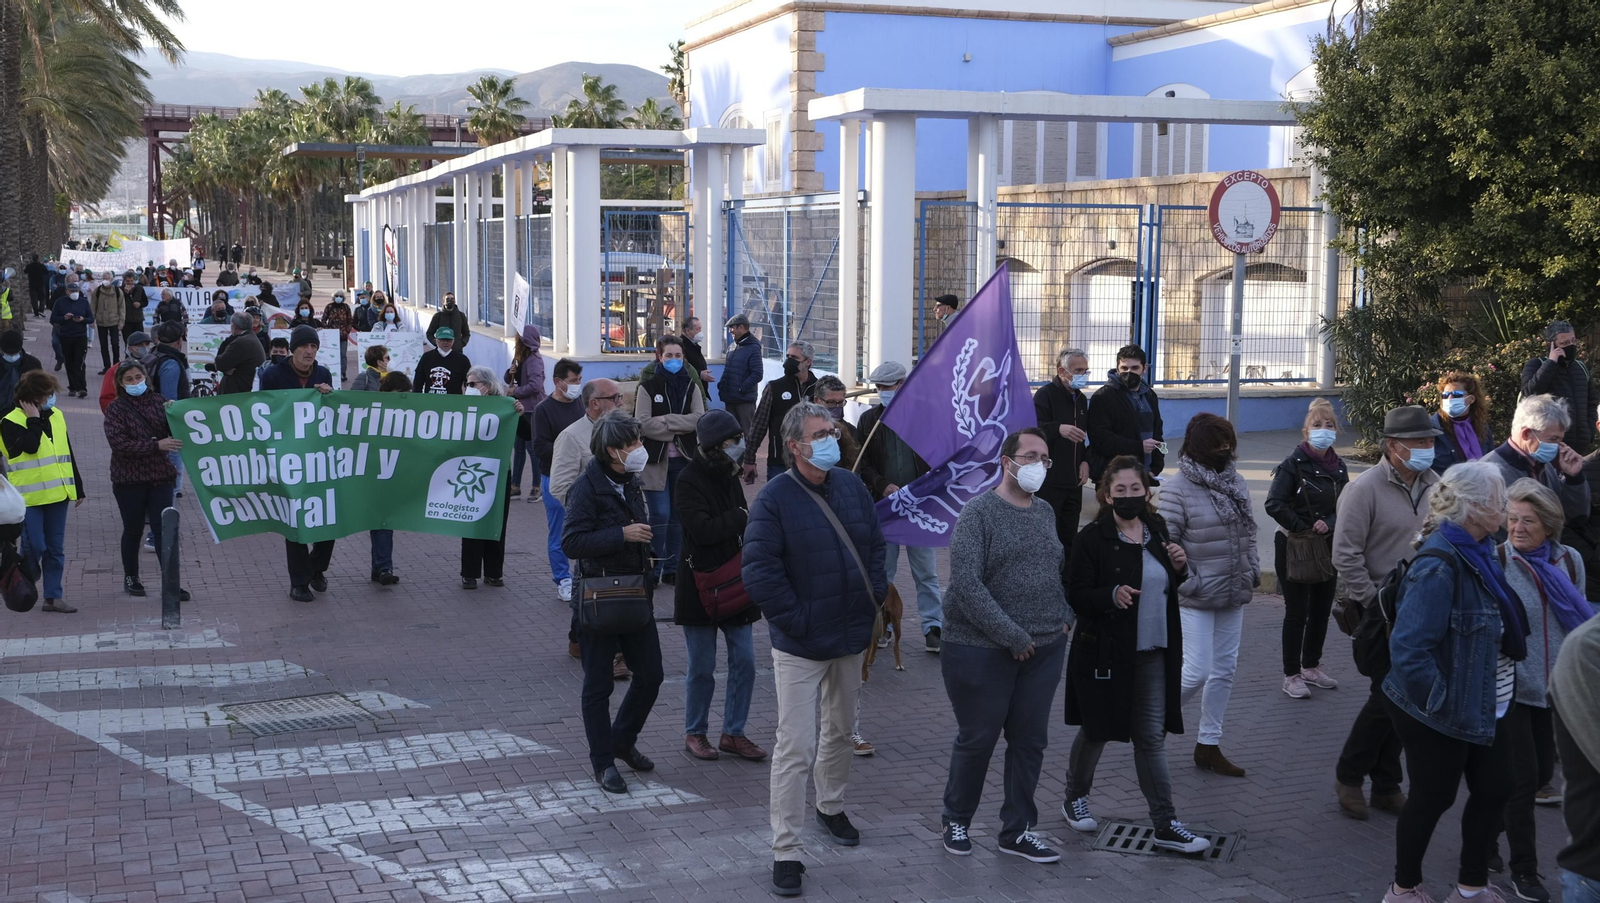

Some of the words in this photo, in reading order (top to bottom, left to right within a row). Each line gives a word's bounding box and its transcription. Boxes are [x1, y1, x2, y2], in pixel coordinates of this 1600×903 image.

[1223, 172, 1269, 189] EXCEPTO
[1240, 222, 1277, 253] AUTORIZADOS
[183, 402, 283, 445] S.O.S.
[293, 401, 500, 442] Patrimonio
[197, 442, 370, 487] ambiental
[376, 448, 401, 480] y
[209, 488, 337, 529] cultural
[427, 509, 440, 517] en
[442, 509, 474, 521] acción
[428, 501, 480, 513] ecologistas
